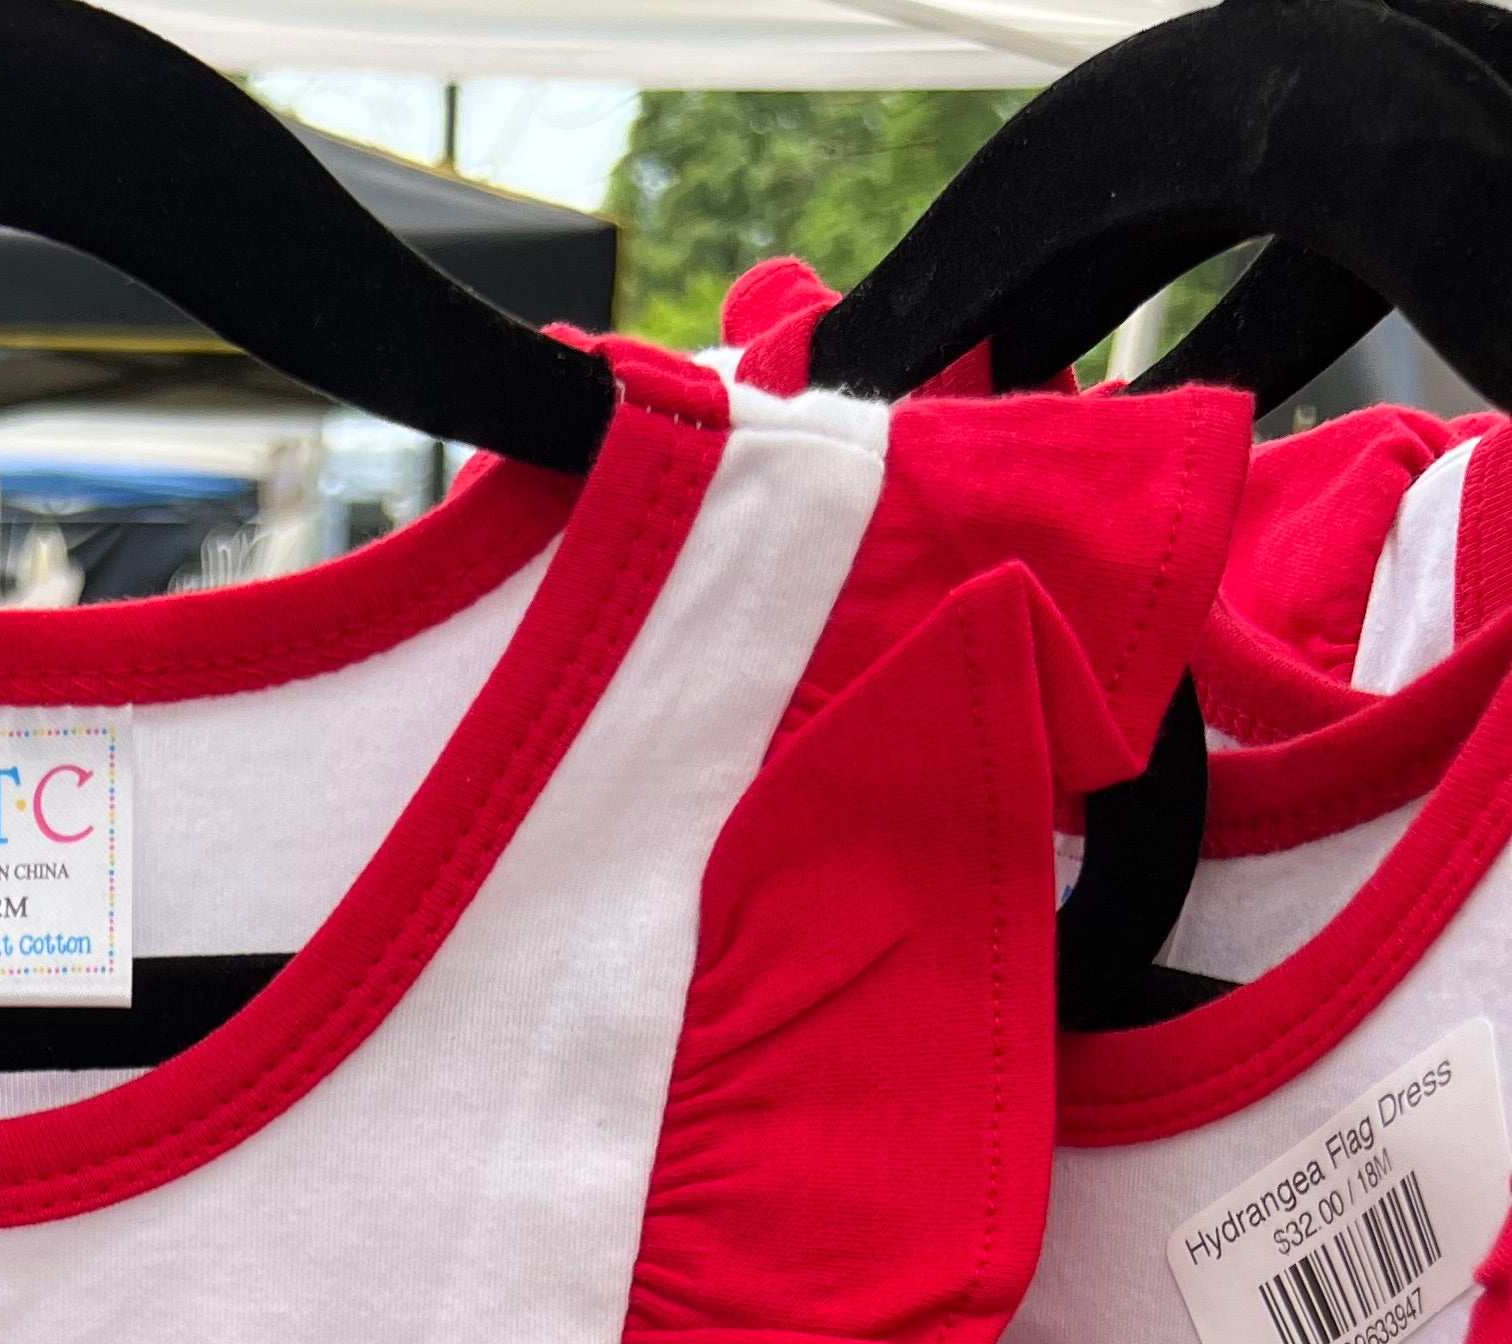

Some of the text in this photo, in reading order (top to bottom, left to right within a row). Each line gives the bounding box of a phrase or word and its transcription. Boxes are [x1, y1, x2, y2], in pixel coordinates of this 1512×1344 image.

[14, 862, 69, 880] CHINA
[19, 933, 92, 955] Cotton
[1185, 1060, 1452, 1266] Hydrangea Flag Dress
[1273, 1190, 1345, 1256] $32.00
[1356, 1147, 1393, 1196] 18M
